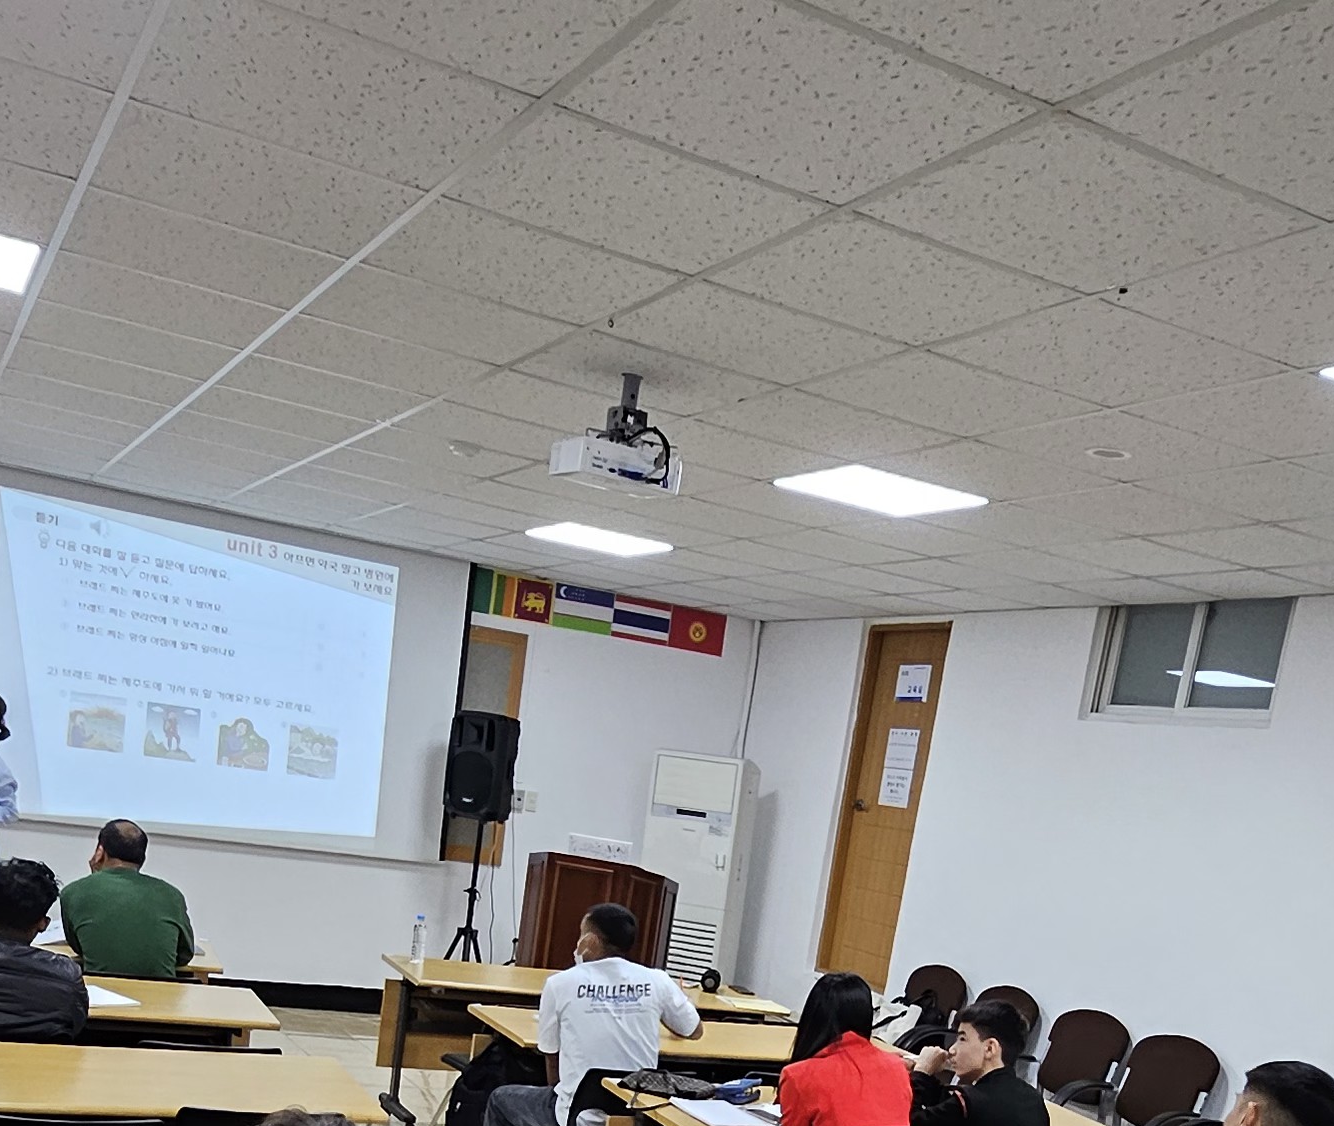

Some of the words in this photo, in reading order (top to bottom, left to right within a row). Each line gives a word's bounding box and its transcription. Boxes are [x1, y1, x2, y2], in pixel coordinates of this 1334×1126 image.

[56, 538, 76, 552] 다음
[227, 538, 263, 557] unit
[268, 545, 278, 559] 3
[59, 557, 68, 567] 1)
[47, 666, 58, 676] 2)
[577, 984, 651, 998] CHALLENGE
